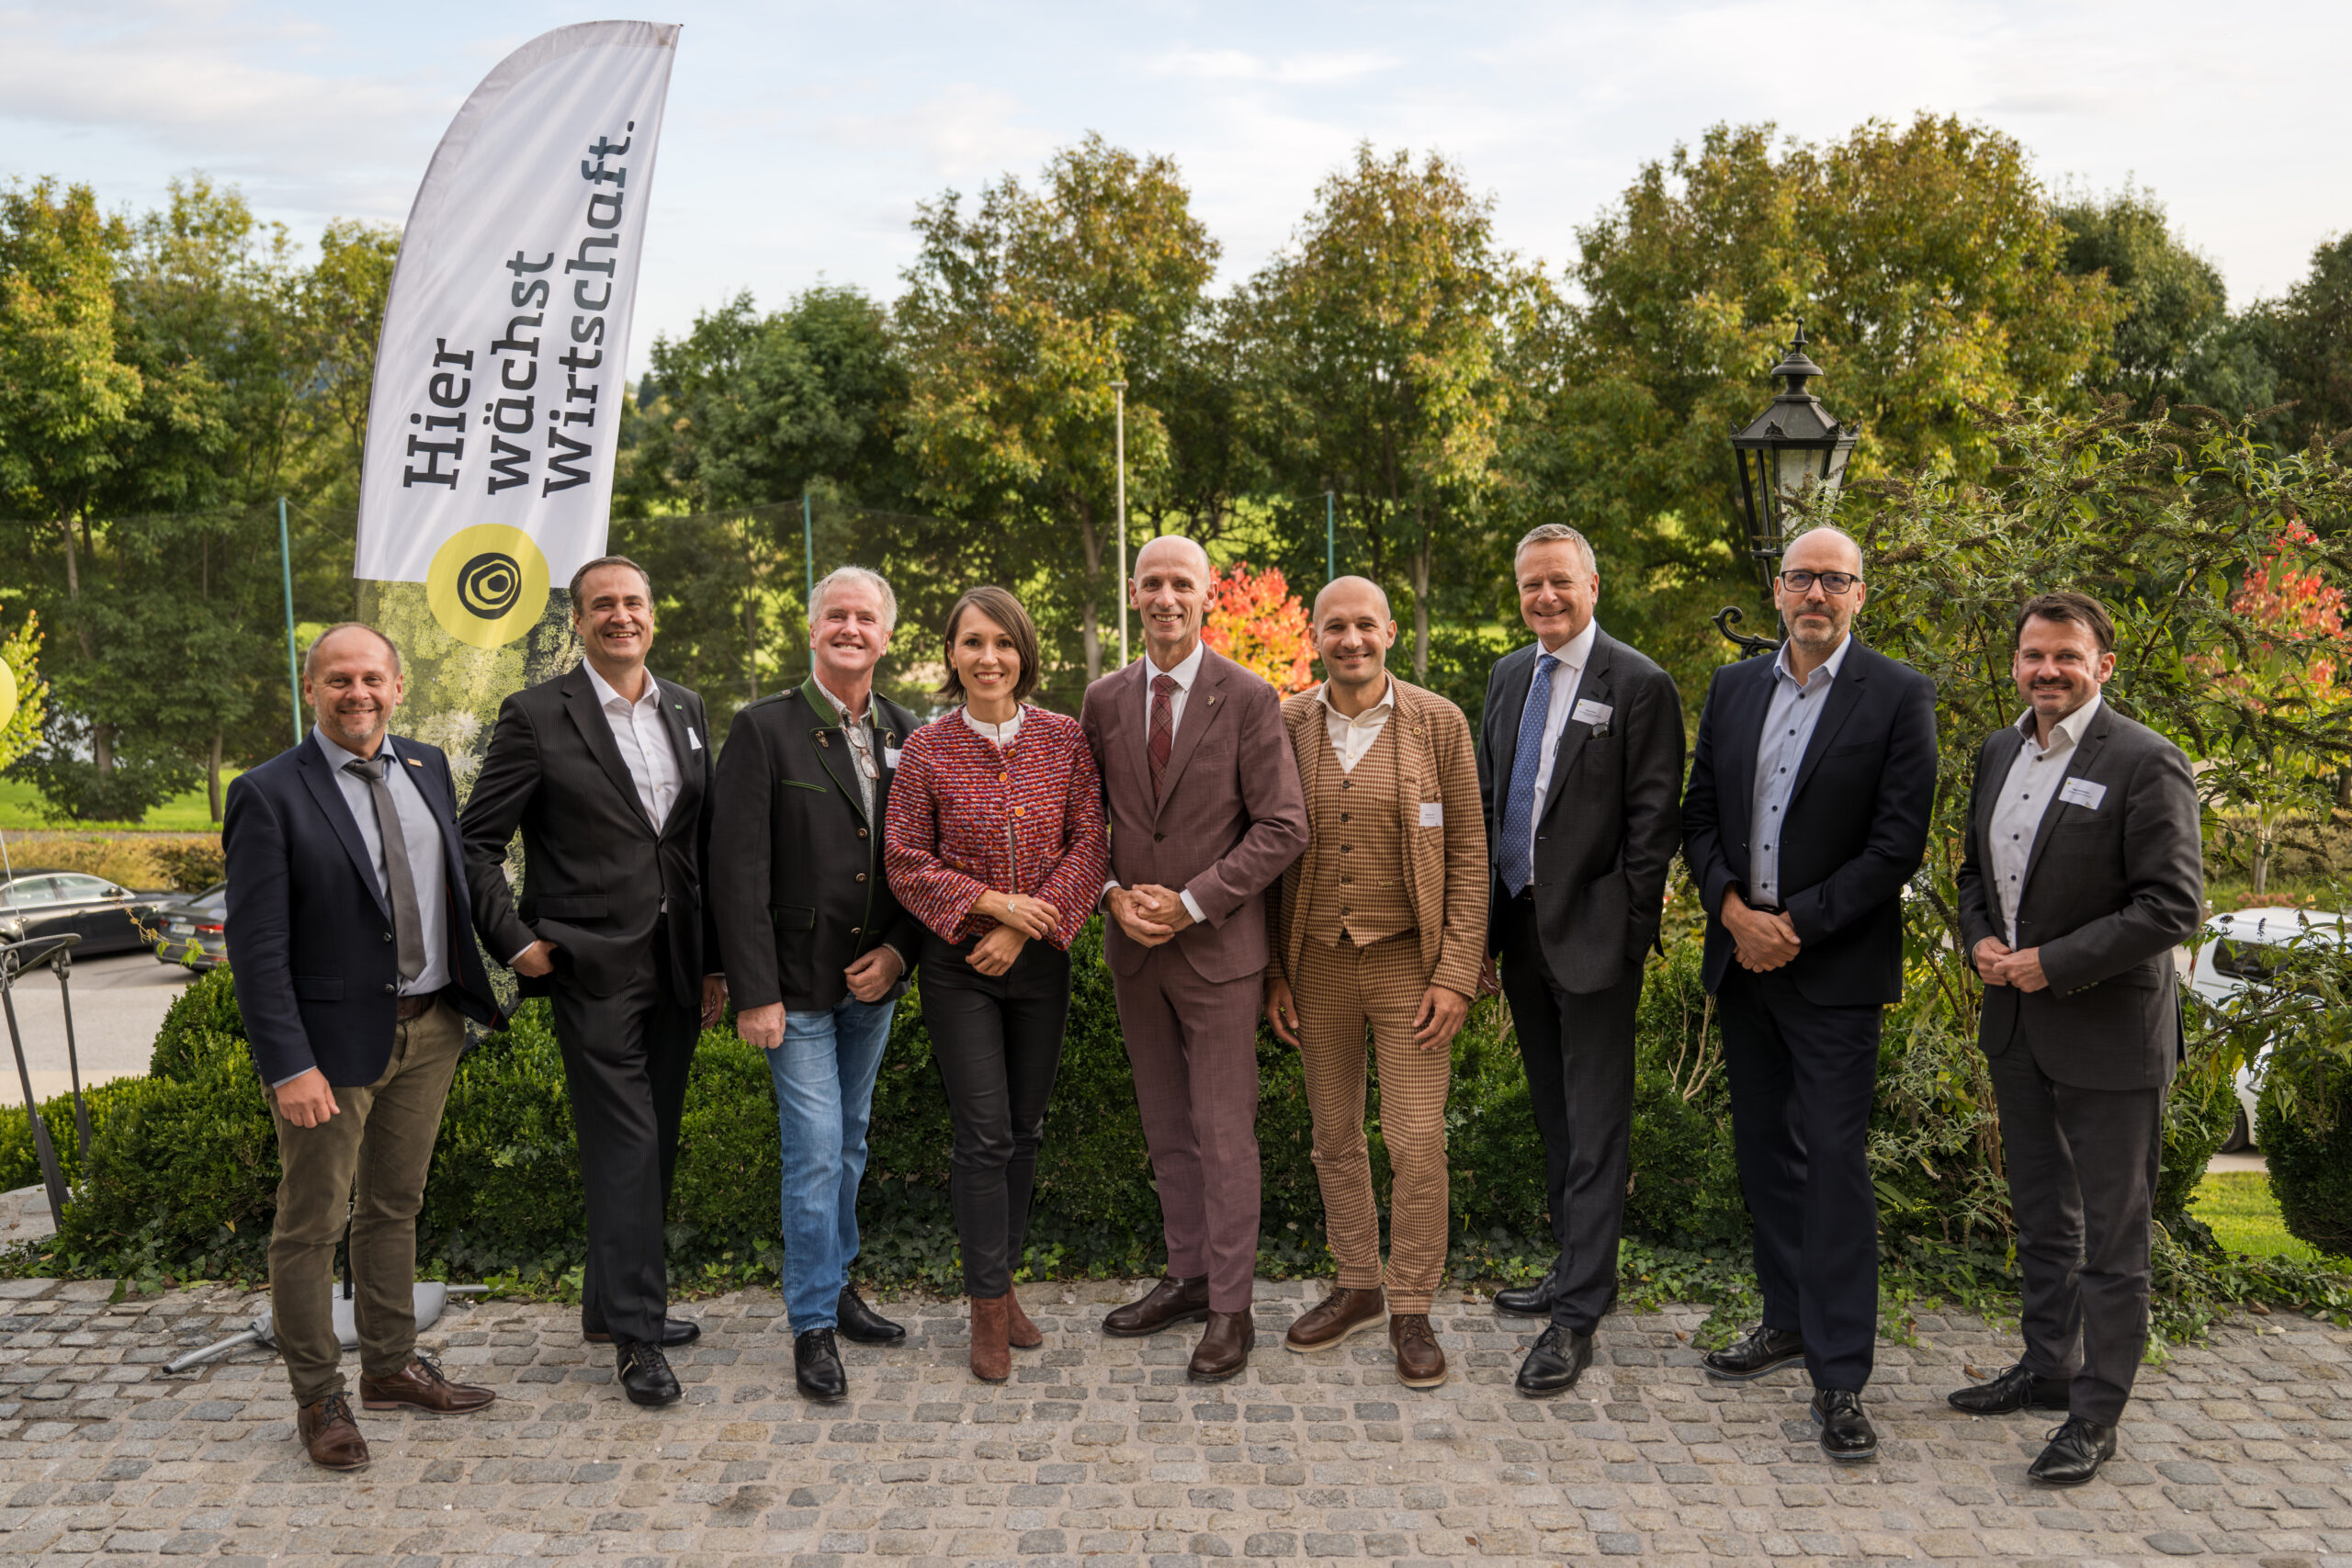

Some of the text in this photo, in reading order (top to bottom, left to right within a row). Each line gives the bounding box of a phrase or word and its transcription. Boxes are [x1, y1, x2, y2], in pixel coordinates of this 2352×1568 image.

[403, 337, 474, 491] Hier
[483, 250, 555, 496] wächst
[541, 120, 635, 499] Wirtschaft.
